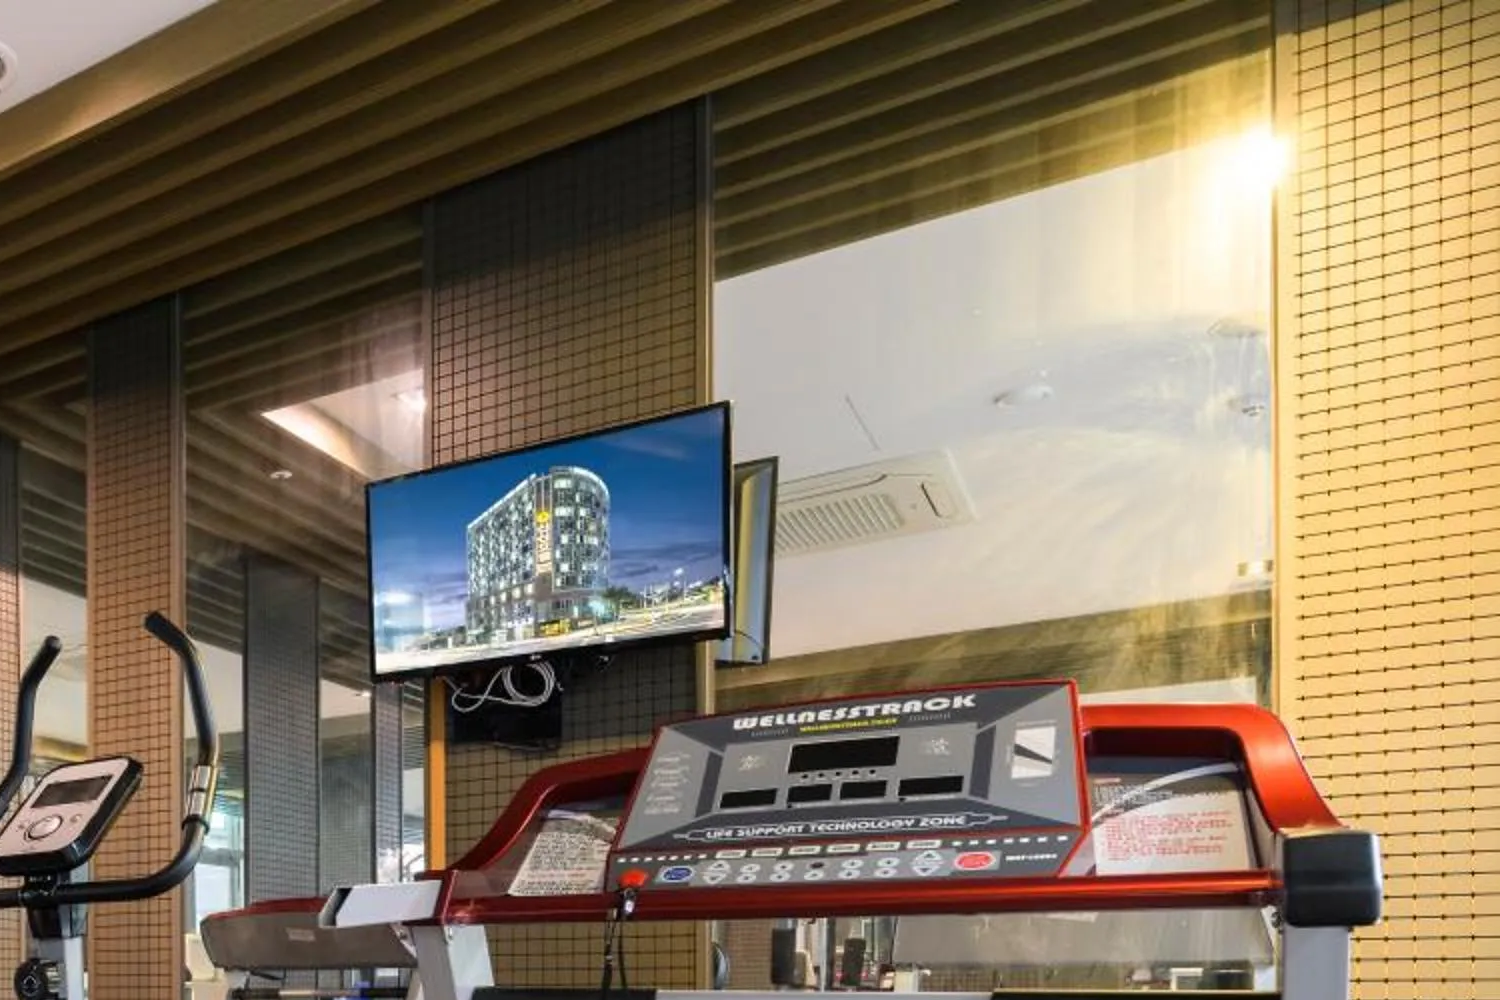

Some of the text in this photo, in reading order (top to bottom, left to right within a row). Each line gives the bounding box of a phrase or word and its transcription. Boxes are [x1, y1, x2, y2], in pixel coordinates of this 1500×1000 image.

[732, 693, 977, 731] WELLNESSTRACK
[735, 824, 804, 837] SUPPORT
[809, 818, 916, 833] TECHNOLOGY
[918, 815, 967, 828] ZONE
